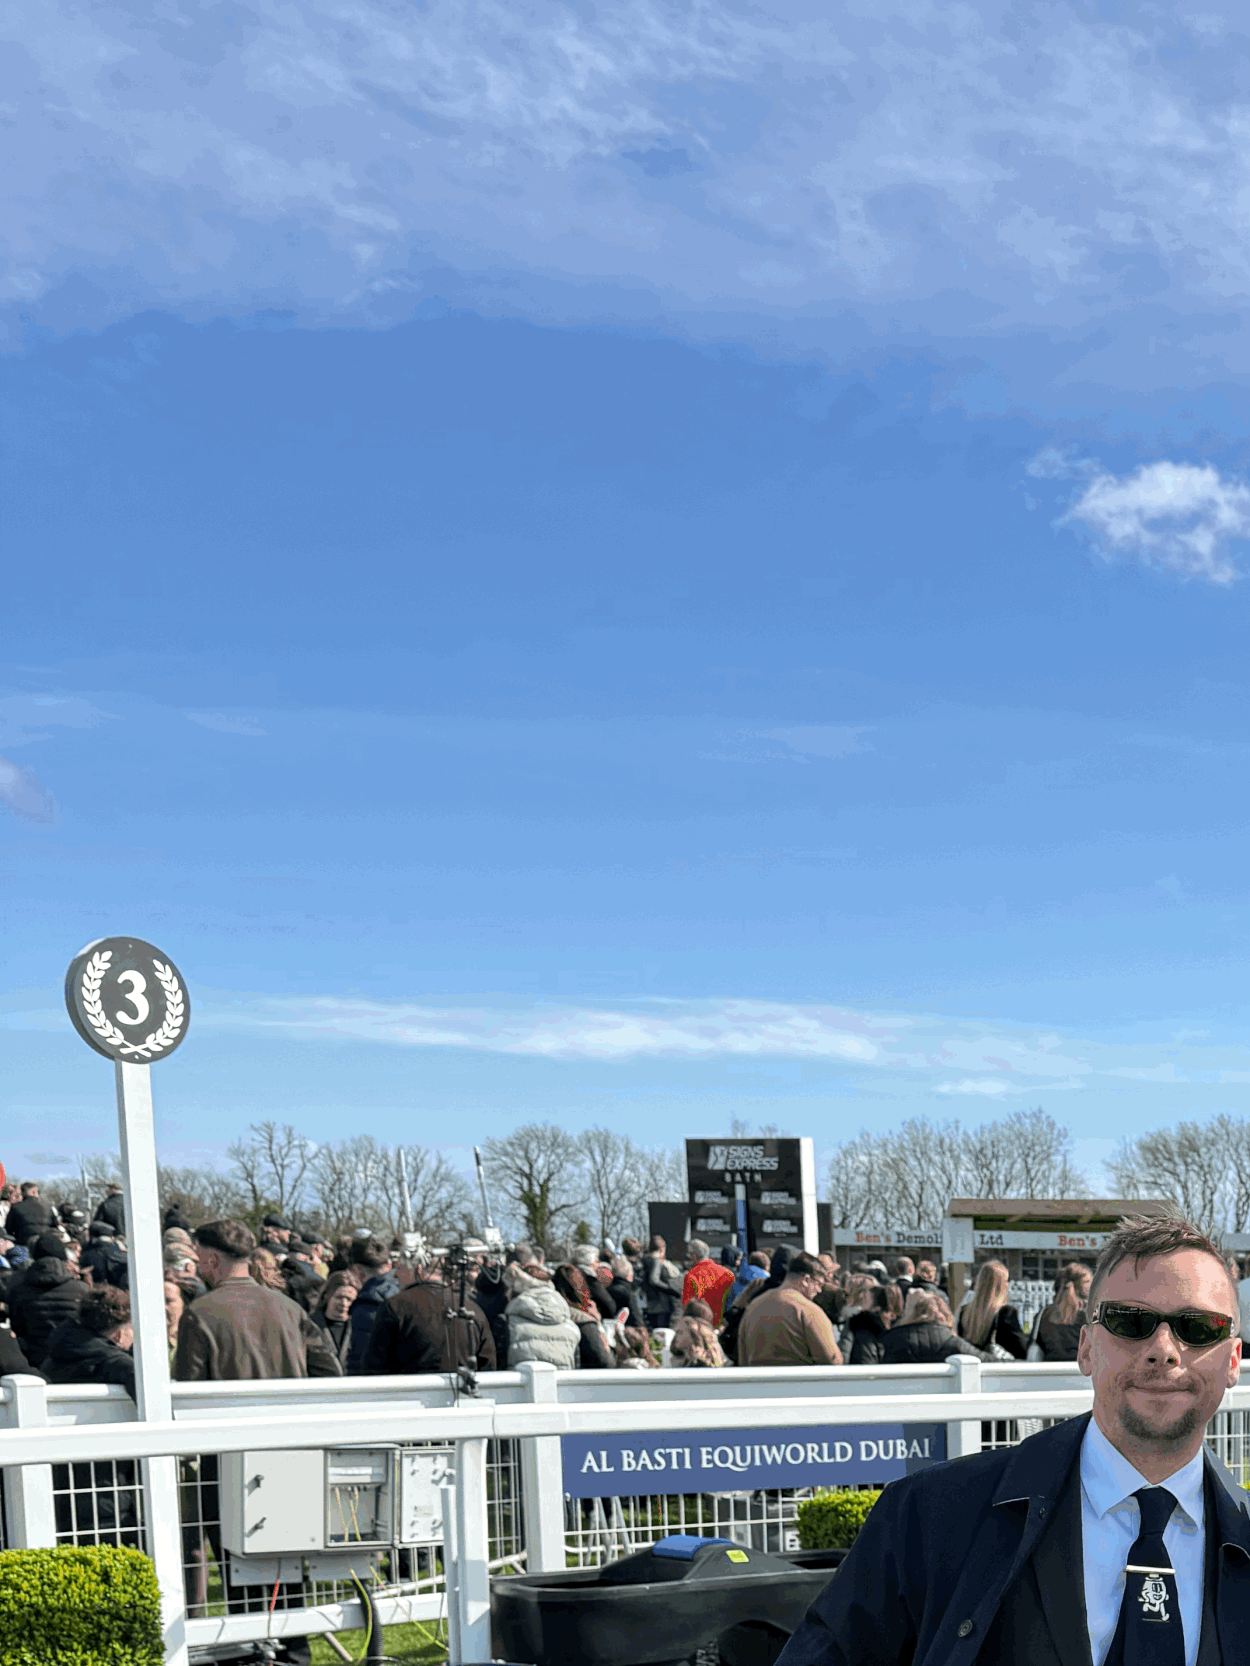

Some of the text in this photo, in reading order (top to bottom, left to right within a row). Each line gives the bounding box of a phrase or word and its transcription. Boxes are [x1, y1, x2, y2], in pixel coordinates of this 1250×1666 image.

[116, 970, 149, 1025] 3
[728, 1145, 764, 1158] SIGNS
[726, 1157, 779, 1170] EXPRESS
[725, 1172, 762, 1183] BATH
[856, 1232, 891, 1244] Ben's
[980, 1233, 1004, 1246] Ltd
[1058, 1235, 1097, 1247] Ben's
[581, 1438, 931, 1473] AL BASTI EQUIWORLD DUBAI
